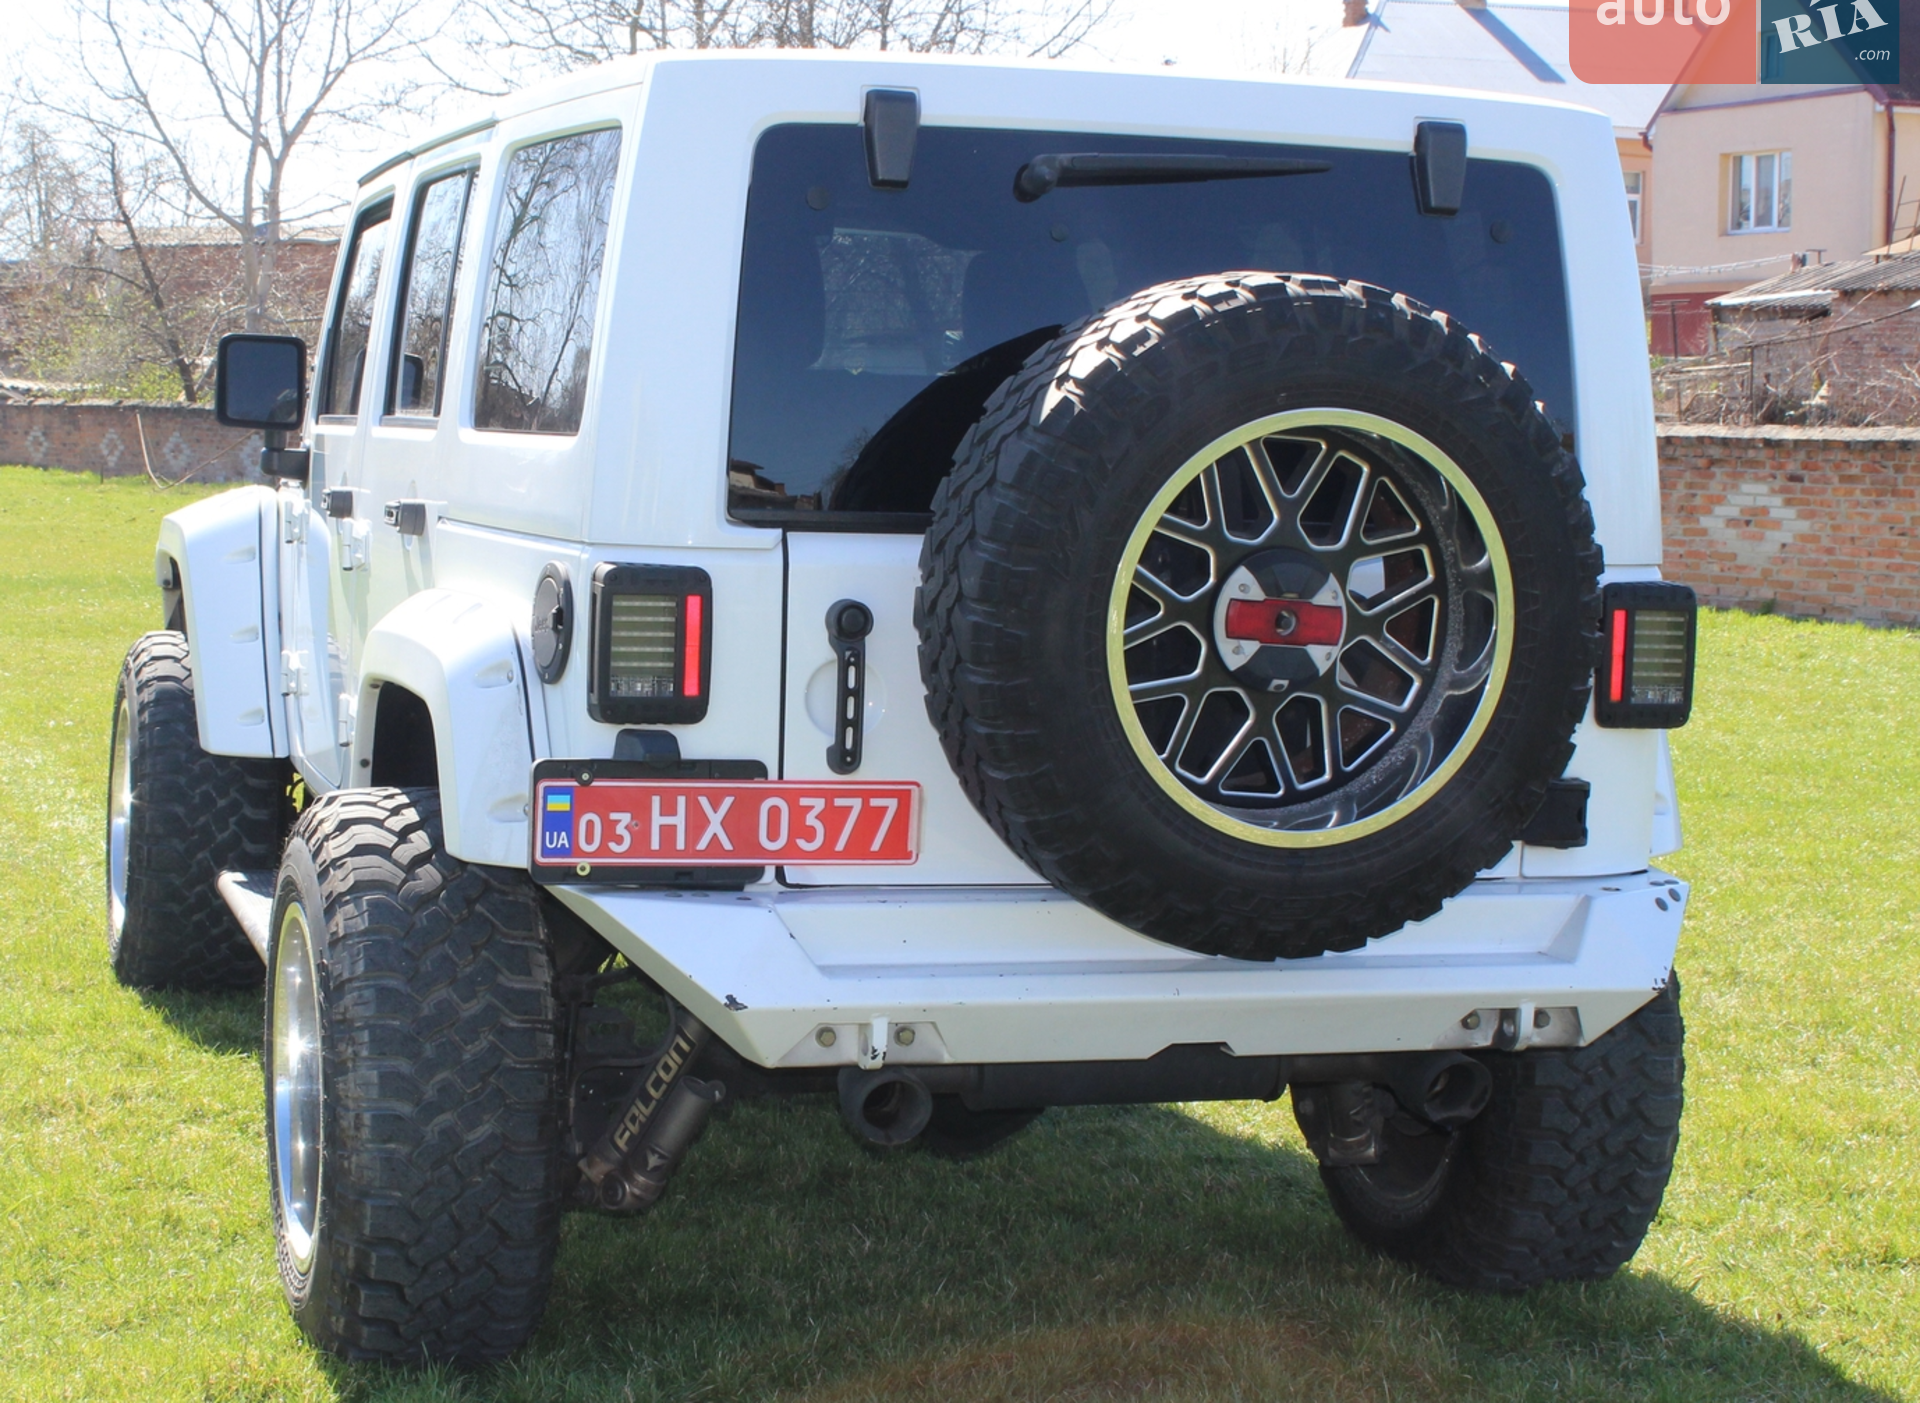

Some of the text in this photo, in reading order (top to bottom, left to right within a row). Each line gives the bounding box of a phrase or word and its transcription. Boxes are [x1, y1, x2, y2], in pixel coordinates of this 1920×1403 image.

[545, 832, 570, 849] UA
[578, 795, 899, 853] 03 HX 0377
[613, 1034, 692, 1153] FALCON
